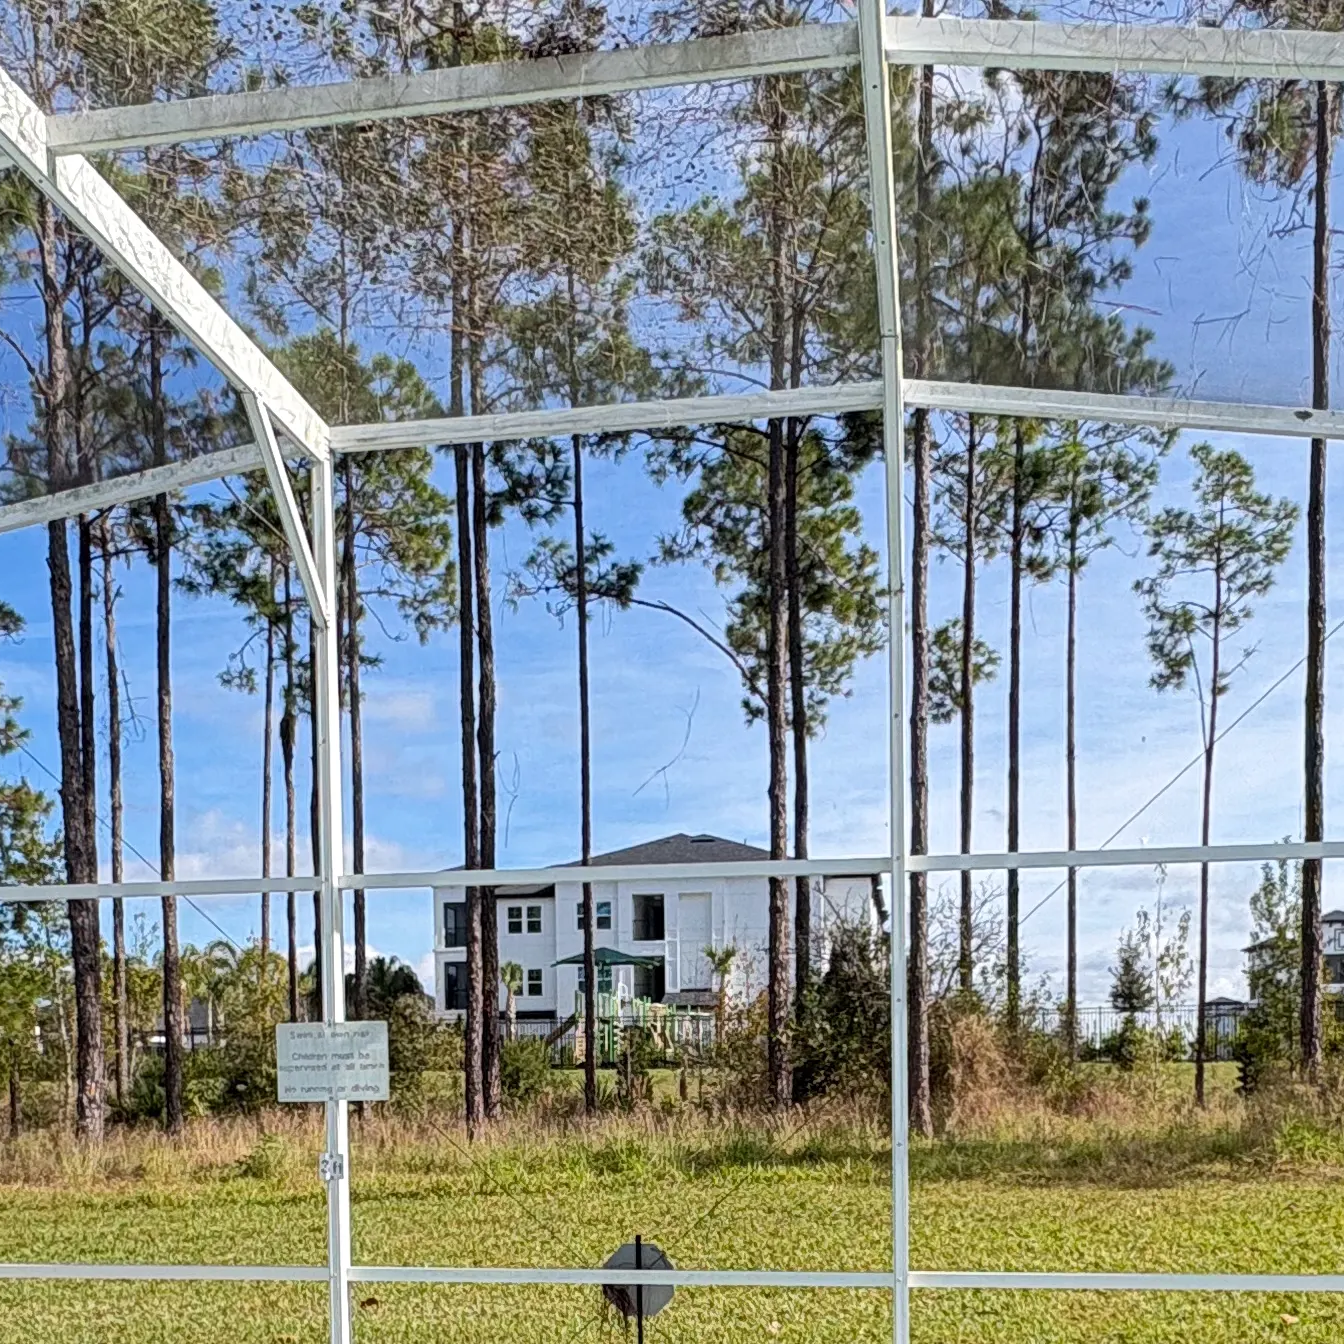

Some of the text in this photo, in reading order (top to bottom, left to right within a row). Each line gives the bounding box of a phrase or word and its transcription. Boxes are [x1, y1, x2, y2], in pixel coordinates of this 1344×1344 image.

[292, 1051, 370, 1061] Children must be
[331, 1063, 340, 1071] at
[300, 1086, 333, 1095] running
[351, 1084, 380, 1095] diving
